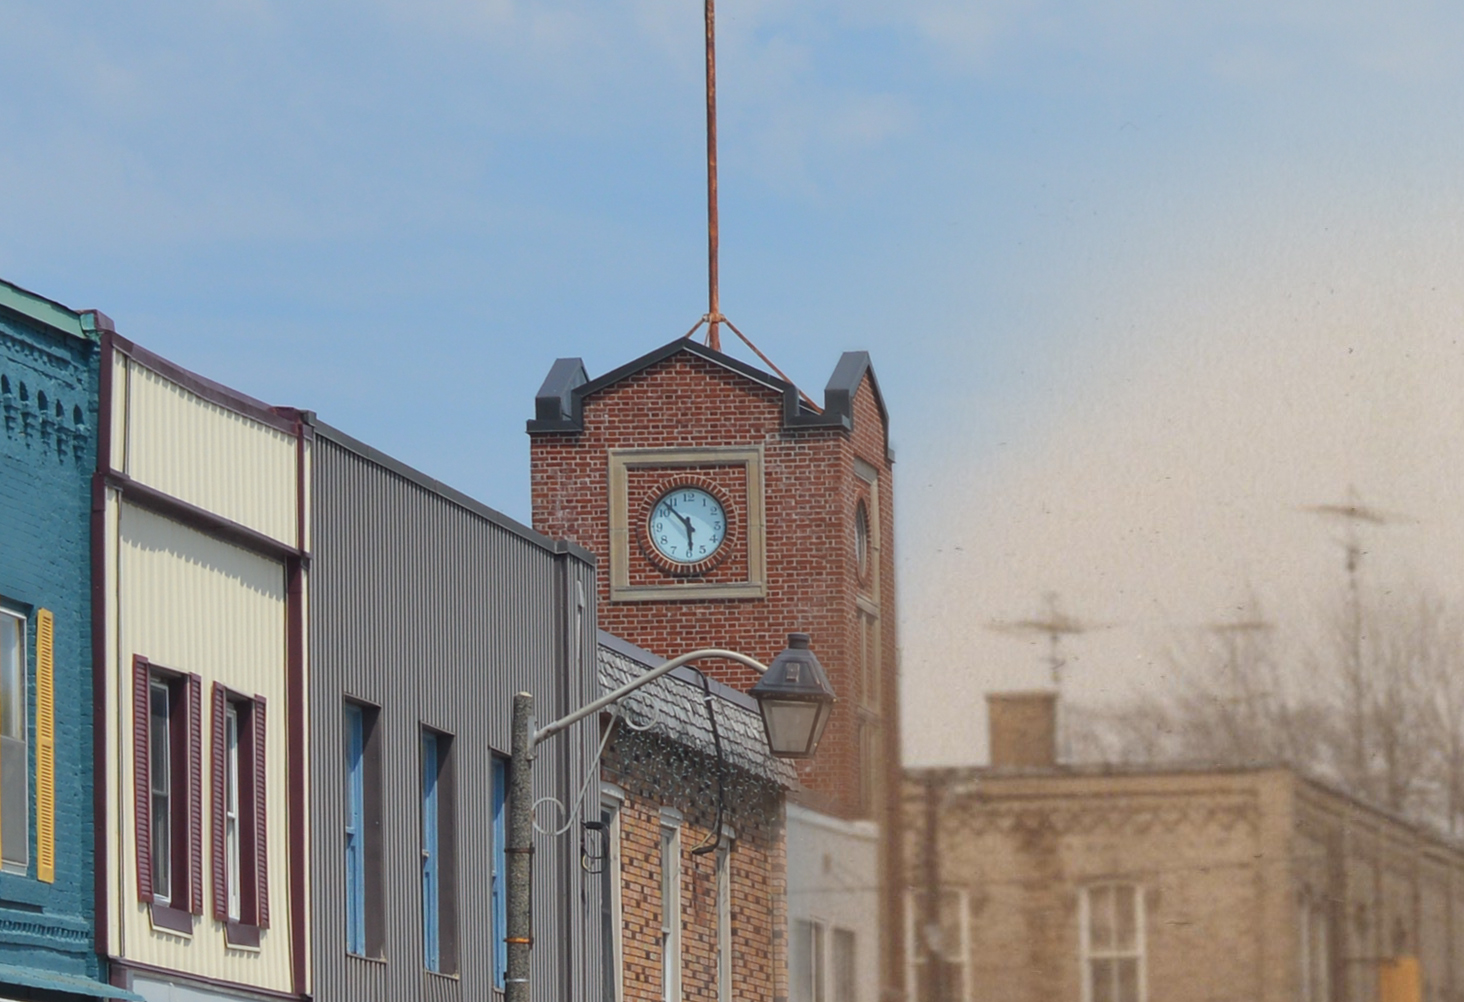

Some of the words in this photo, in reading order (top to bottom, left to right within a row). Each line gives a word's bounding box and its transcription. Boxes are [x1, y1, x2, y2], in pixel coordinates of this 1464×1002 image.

[683, 493, 695, 502] 12
[660, 508, 670, 517] 10
[710, 506, 718, 515] 2
[656, 523, 663, 532] 9
[714, 521, 721, 530] 3
[660, 535, 668, 545] 8
[709, 534, 718, 543] 4
[671, 546, 677, 554] 7
[686, 549, 693, 558] 6
[699, 545, 706, 554] 5
